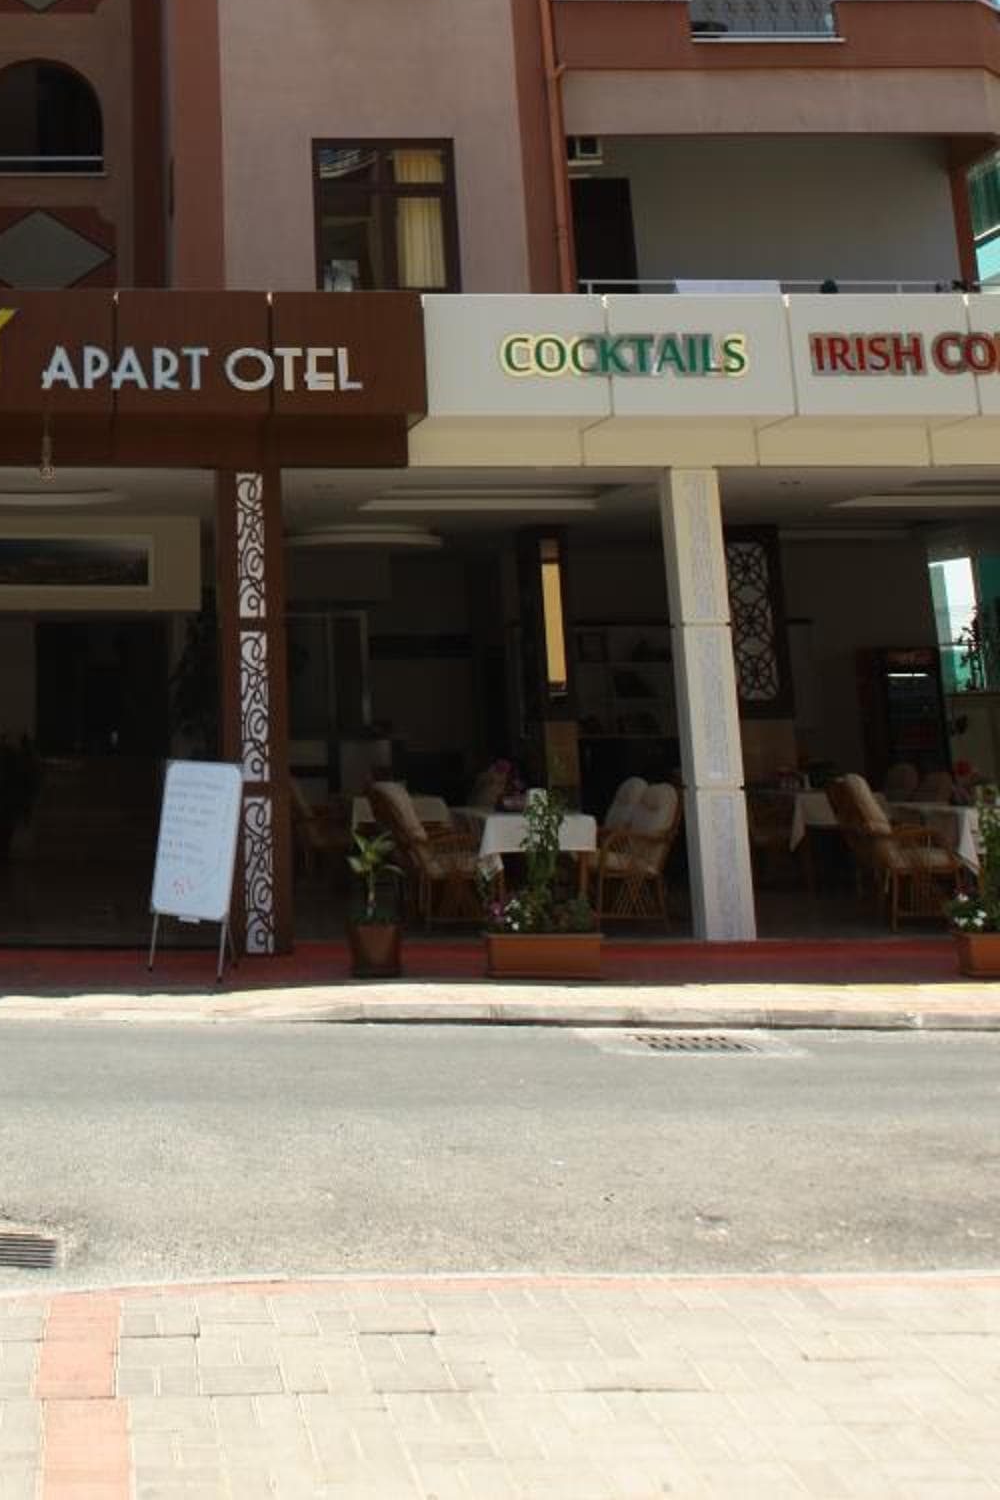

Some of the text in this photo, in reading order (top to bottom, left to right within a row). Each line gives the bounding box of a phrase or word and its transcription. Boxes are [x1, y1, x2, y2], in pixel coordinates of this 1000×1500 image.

[41, 345, 210, 389] APART
[224, 346, 364, 391] OTEL
[502, 333, 749, 377] COCKTAILS
[809, 332, 1000, 376] IRISH CO
